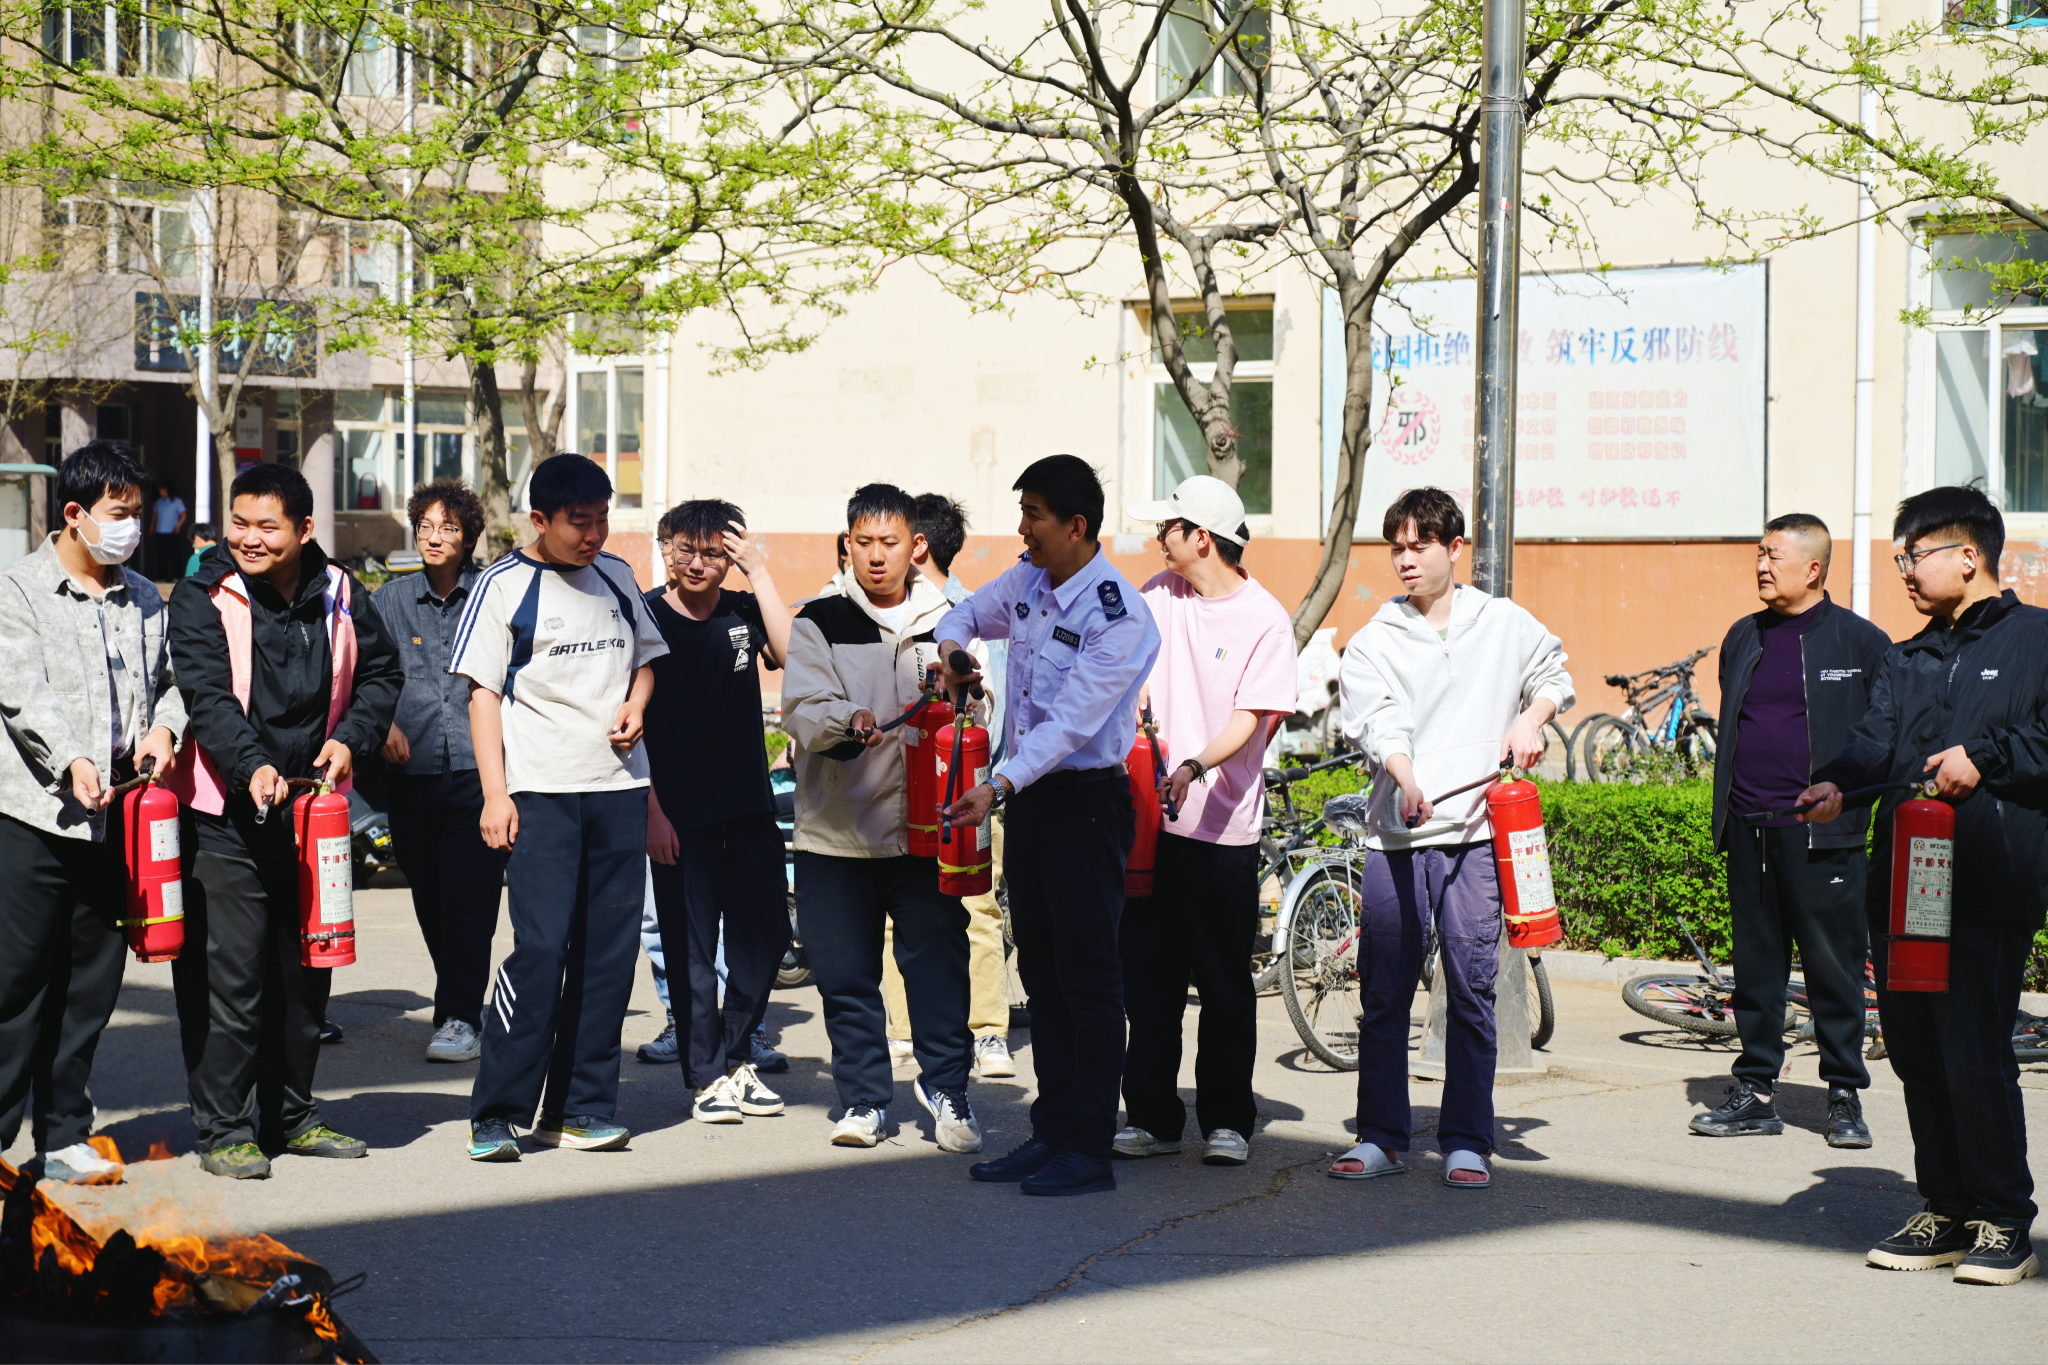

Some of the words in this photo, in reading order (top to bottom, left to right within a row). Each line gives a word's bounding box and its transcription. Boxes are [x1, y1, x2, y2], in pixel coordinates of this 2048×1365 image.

[1546, 322, 1740, 367] 筑牢反邪防线
